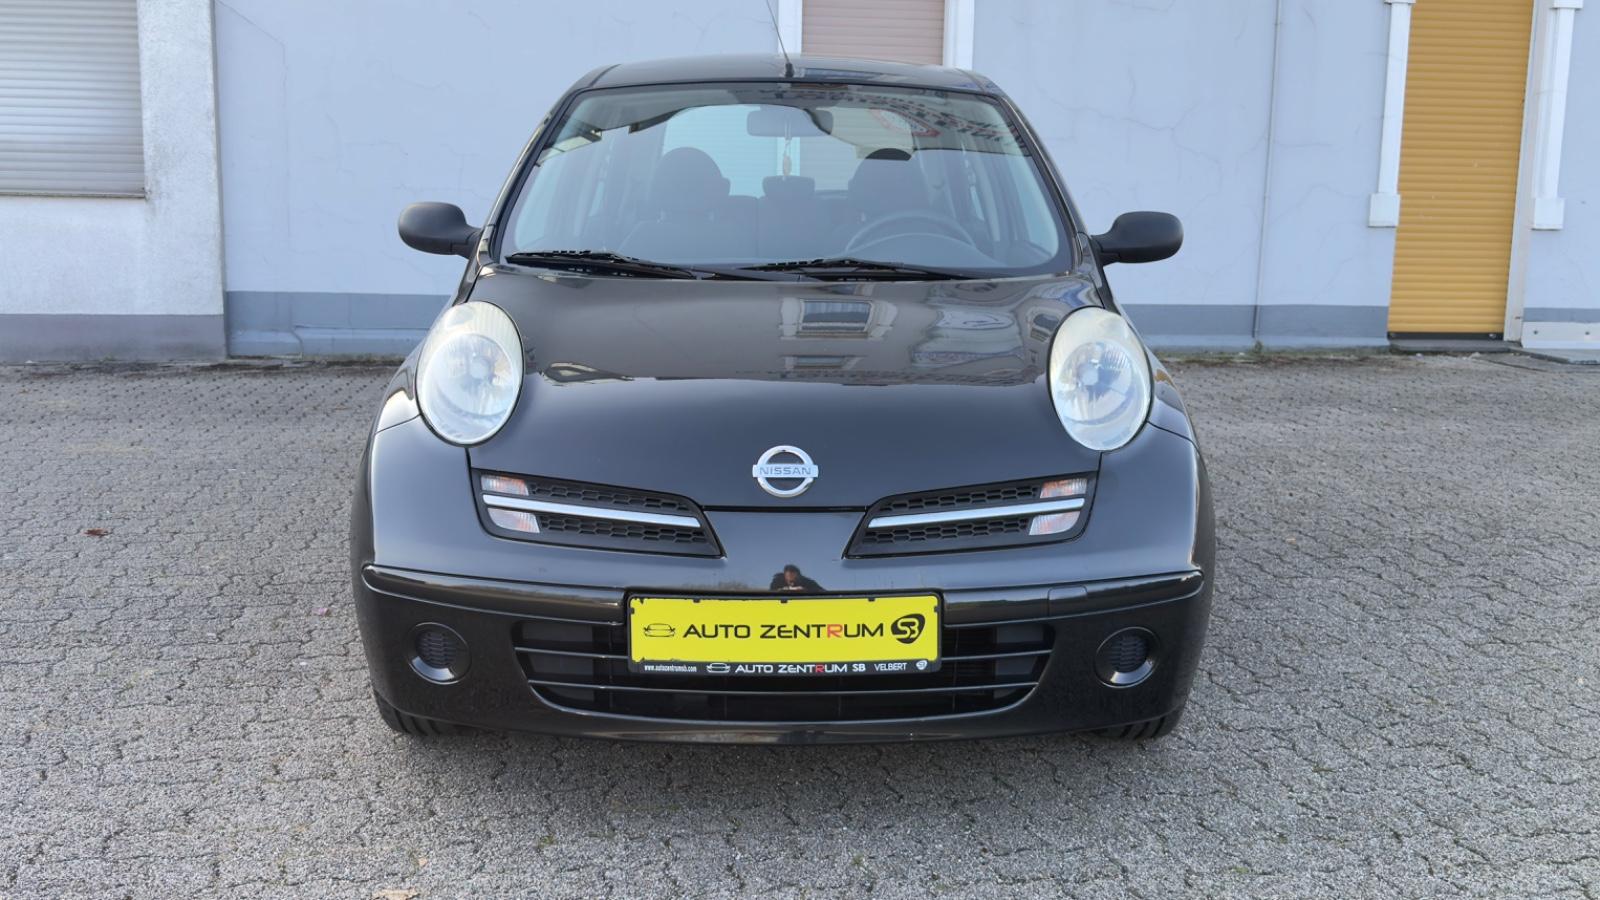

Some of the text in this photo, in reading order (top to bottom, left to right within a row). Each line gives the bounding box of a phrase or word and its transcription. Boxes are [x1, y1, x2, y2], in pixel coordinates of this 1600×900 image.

[759, 466, 812, 475] NISSAN
[683, 624, 751, 639] AUTO
[760, 623, 884, 639] ZENTRUM
[735, 664, 774, 673] AUTO
[778, 664, 847, 673] ZENTRUM
[852, 663, 866, 672] SB
[874, 662, 907, 671] VELBERT
